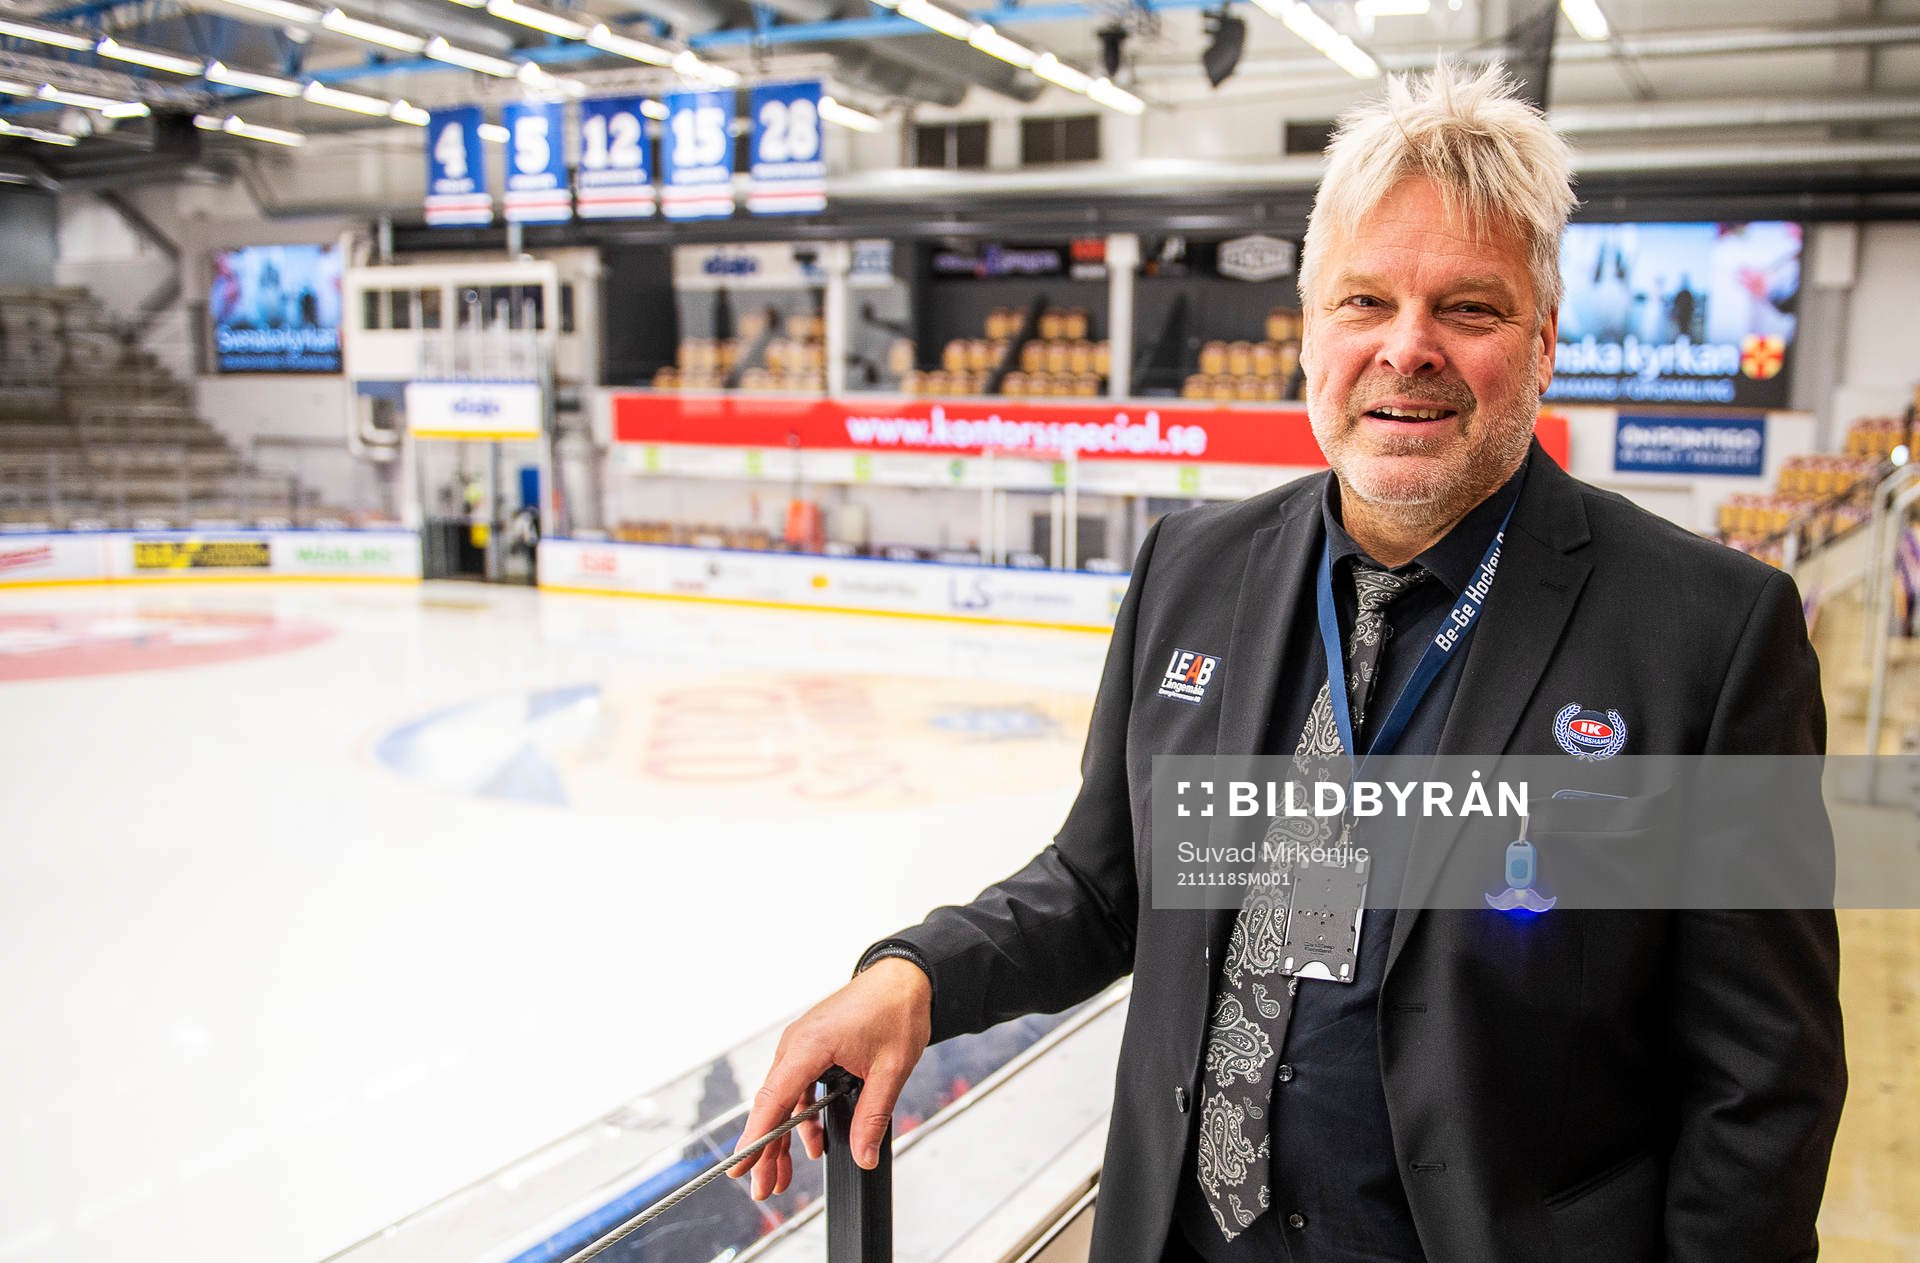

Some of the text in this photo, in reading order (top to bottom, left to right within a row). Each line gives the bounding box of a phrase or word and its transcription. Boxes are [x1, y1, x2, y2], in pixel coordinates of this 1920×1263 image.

[435, 122, 468, 178] 4
[515, 116, 550, 174] 5
[583, 112, 643, 169] 12
[672, 107, 727, 167] 15
[760, 99, 820, 162] 28
[1624, 334, 1740, 382] kyrkan
[846, 404, 1208, 456] www.kontorsspecial.se
[1435, 603, 1475, 652] Be-Ge
[1465, 547, 1502, 605] Hockey
[1165, 650, 1216, 686] LEAB
[1569, 731, 1612, 746] OSKARSHAMN
[1580, 722, 1603, 735] IK
